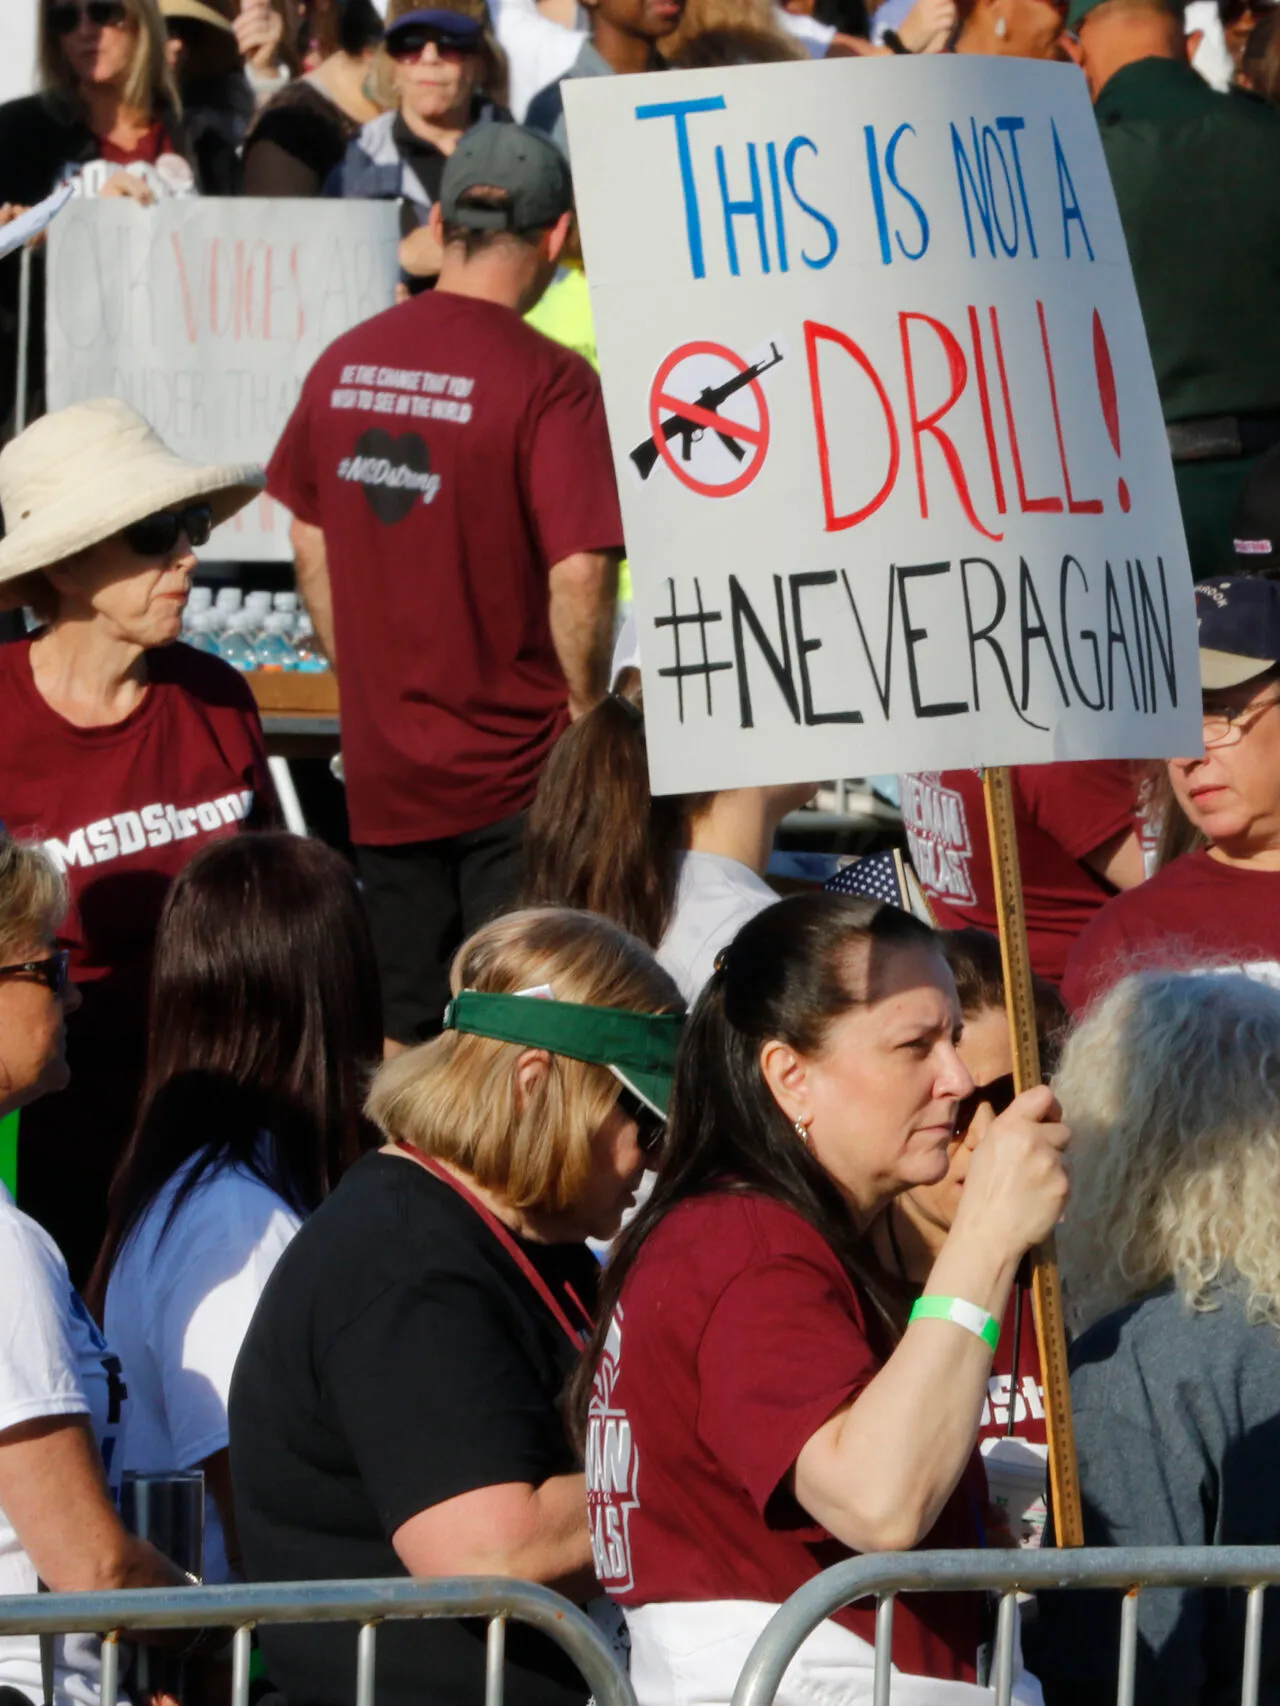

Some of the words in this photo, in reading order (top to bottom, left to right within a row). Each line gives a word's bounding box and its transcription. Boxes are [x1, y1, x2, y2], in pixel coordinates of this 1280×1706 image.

[635, 95, 839, 279] THIS
[863, 122, 930, 265] IS
[949, 115, 1038, 260] NOT
[1050, 117, 1095, 262] A
[170, 230, 306, 346] VOICES
[803, 299, 1132, 542] DRILL!
[654, 554, 1178, 731] #NEVERAGAIN
